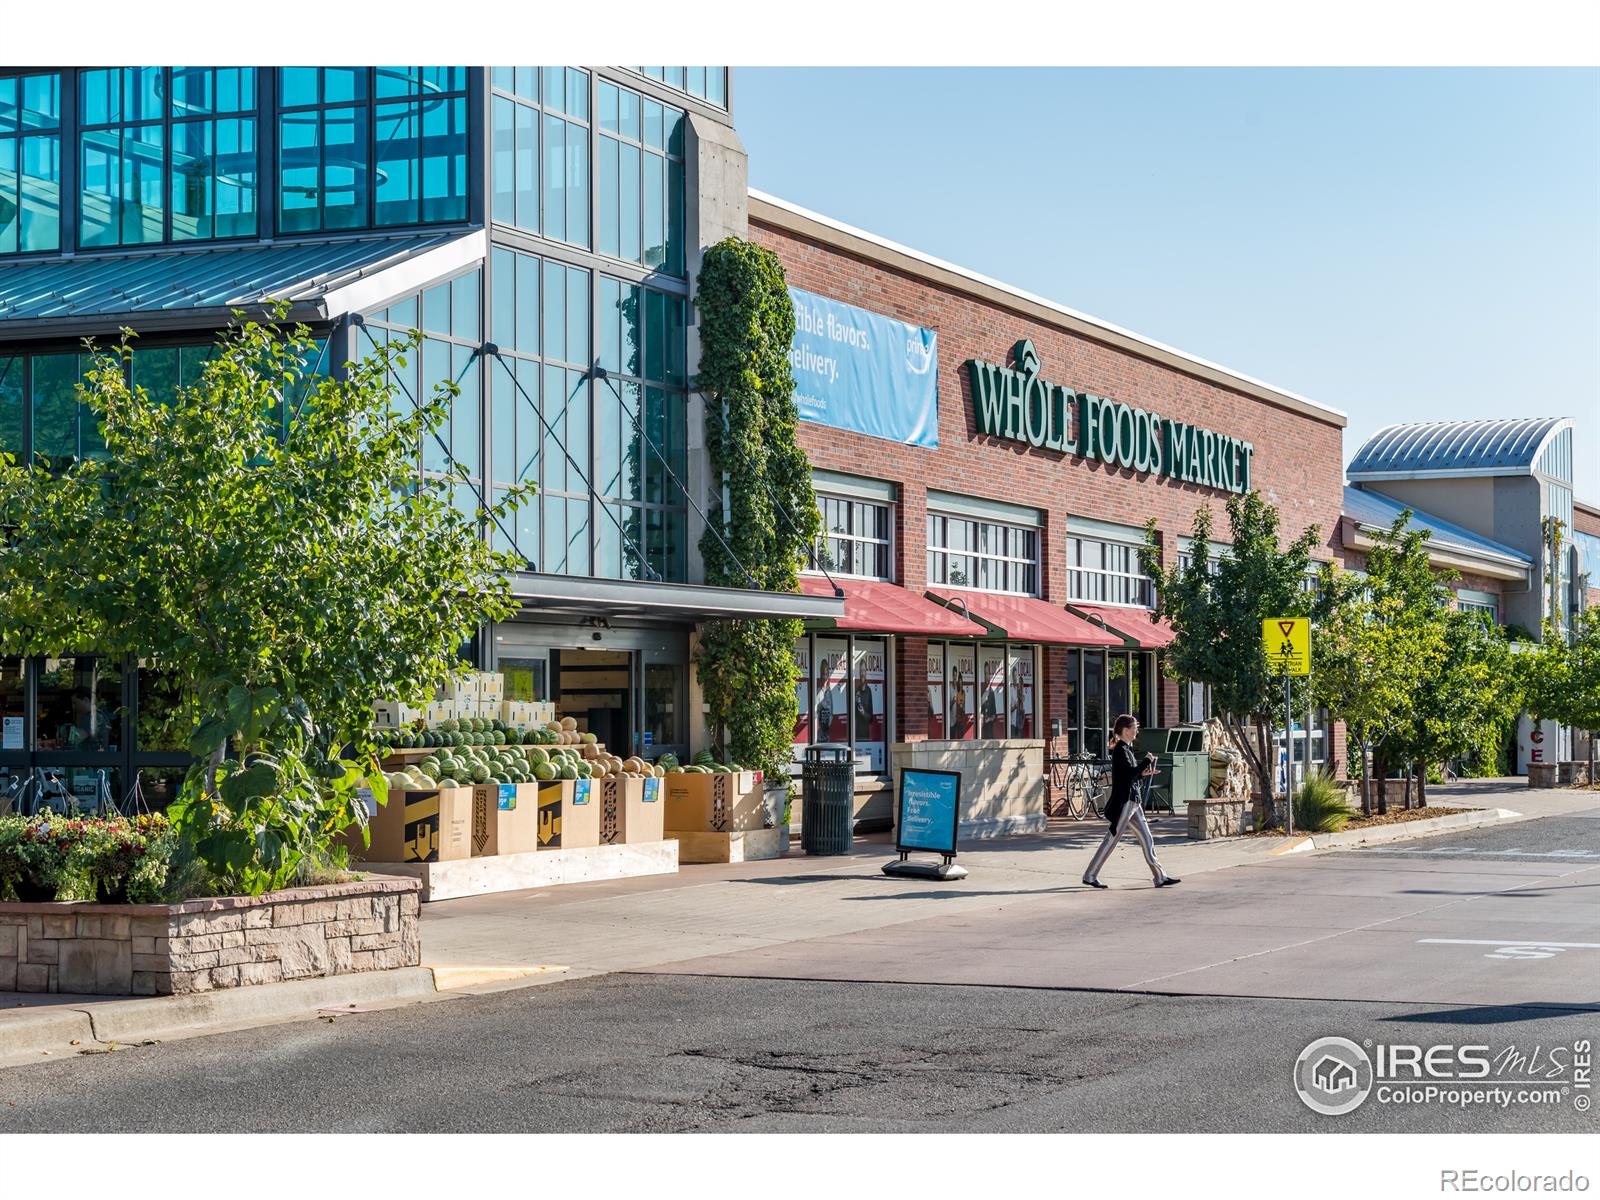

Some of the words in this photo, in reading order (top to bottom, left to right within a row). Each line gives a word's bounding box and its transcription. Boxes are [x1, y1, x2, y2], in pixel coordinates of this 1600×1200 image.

[827, 313, 870, 350] flavors.
[972, 357, 1077, 454] WHOLE
[1085, 394, 1161, 476] FOODS
[1169, 419, 1254, 494] MARKET
[827, 653, 847, 670] LOCAL
[865, 655, 883, 672] LOCAL
[929, 658, 942, 674] OCAL
[958, 659, 973, 674] LOCAL
[1017, 662, 1032, 677] LOCAL
[1530, 730, 1544, 763] CE
